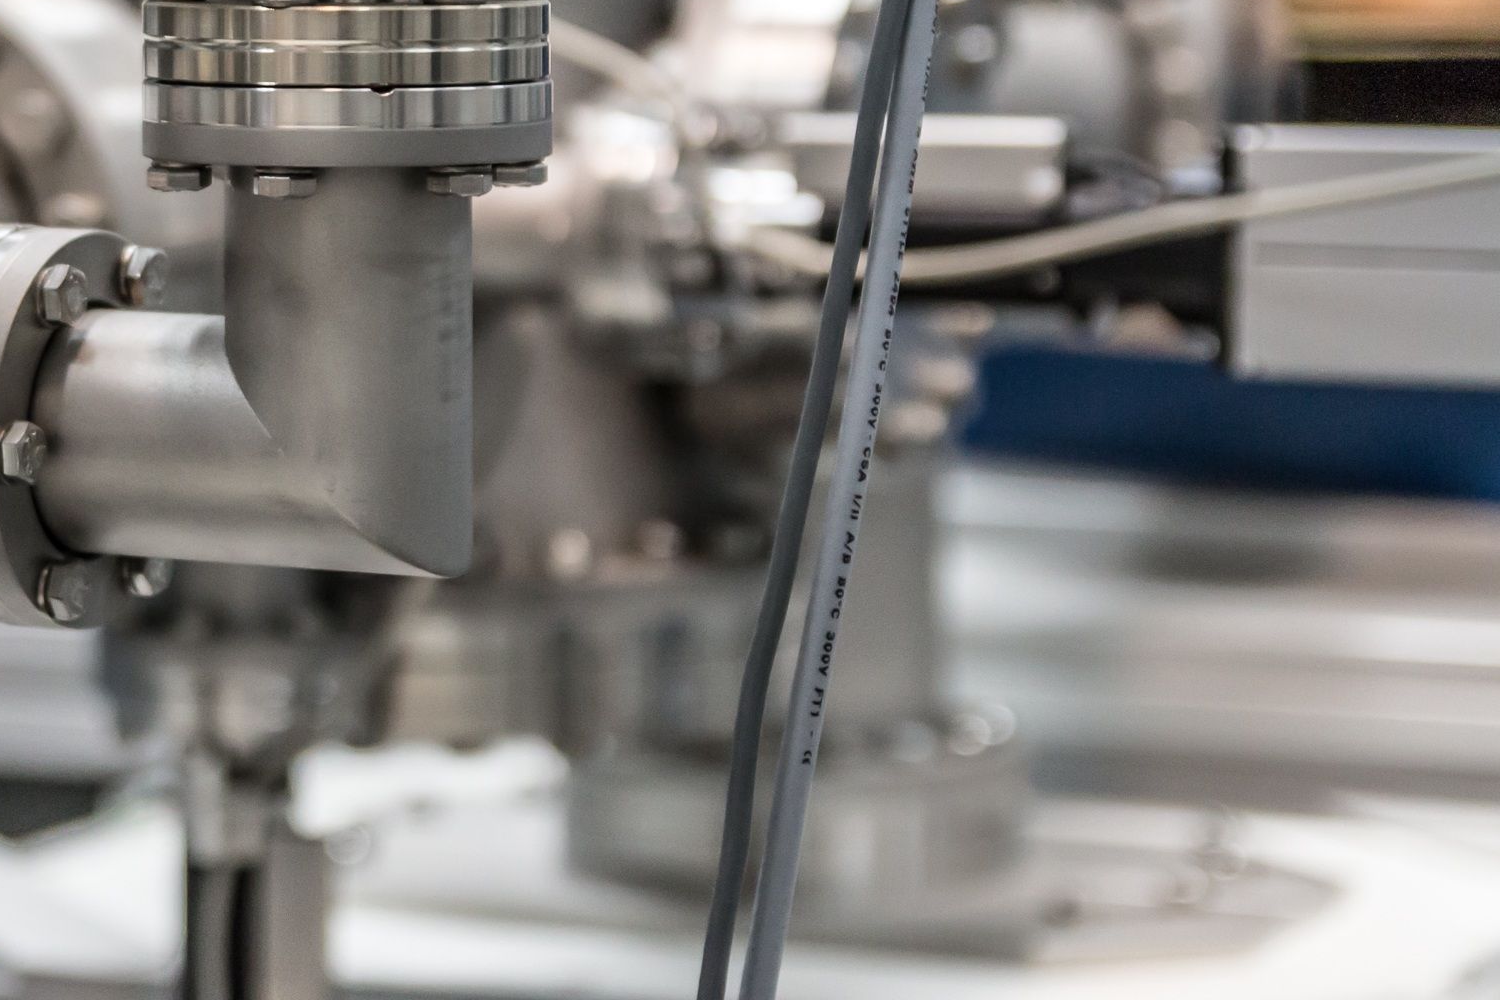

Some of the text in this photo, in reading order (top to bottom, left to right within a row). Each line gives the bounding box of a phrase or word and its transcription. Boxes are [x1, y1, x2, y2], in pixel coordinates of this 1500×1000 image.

[868, 383, 882, 429] 300V
[857, 446, 871, 482] CSA
[818, 630, 835, 677] 300V
